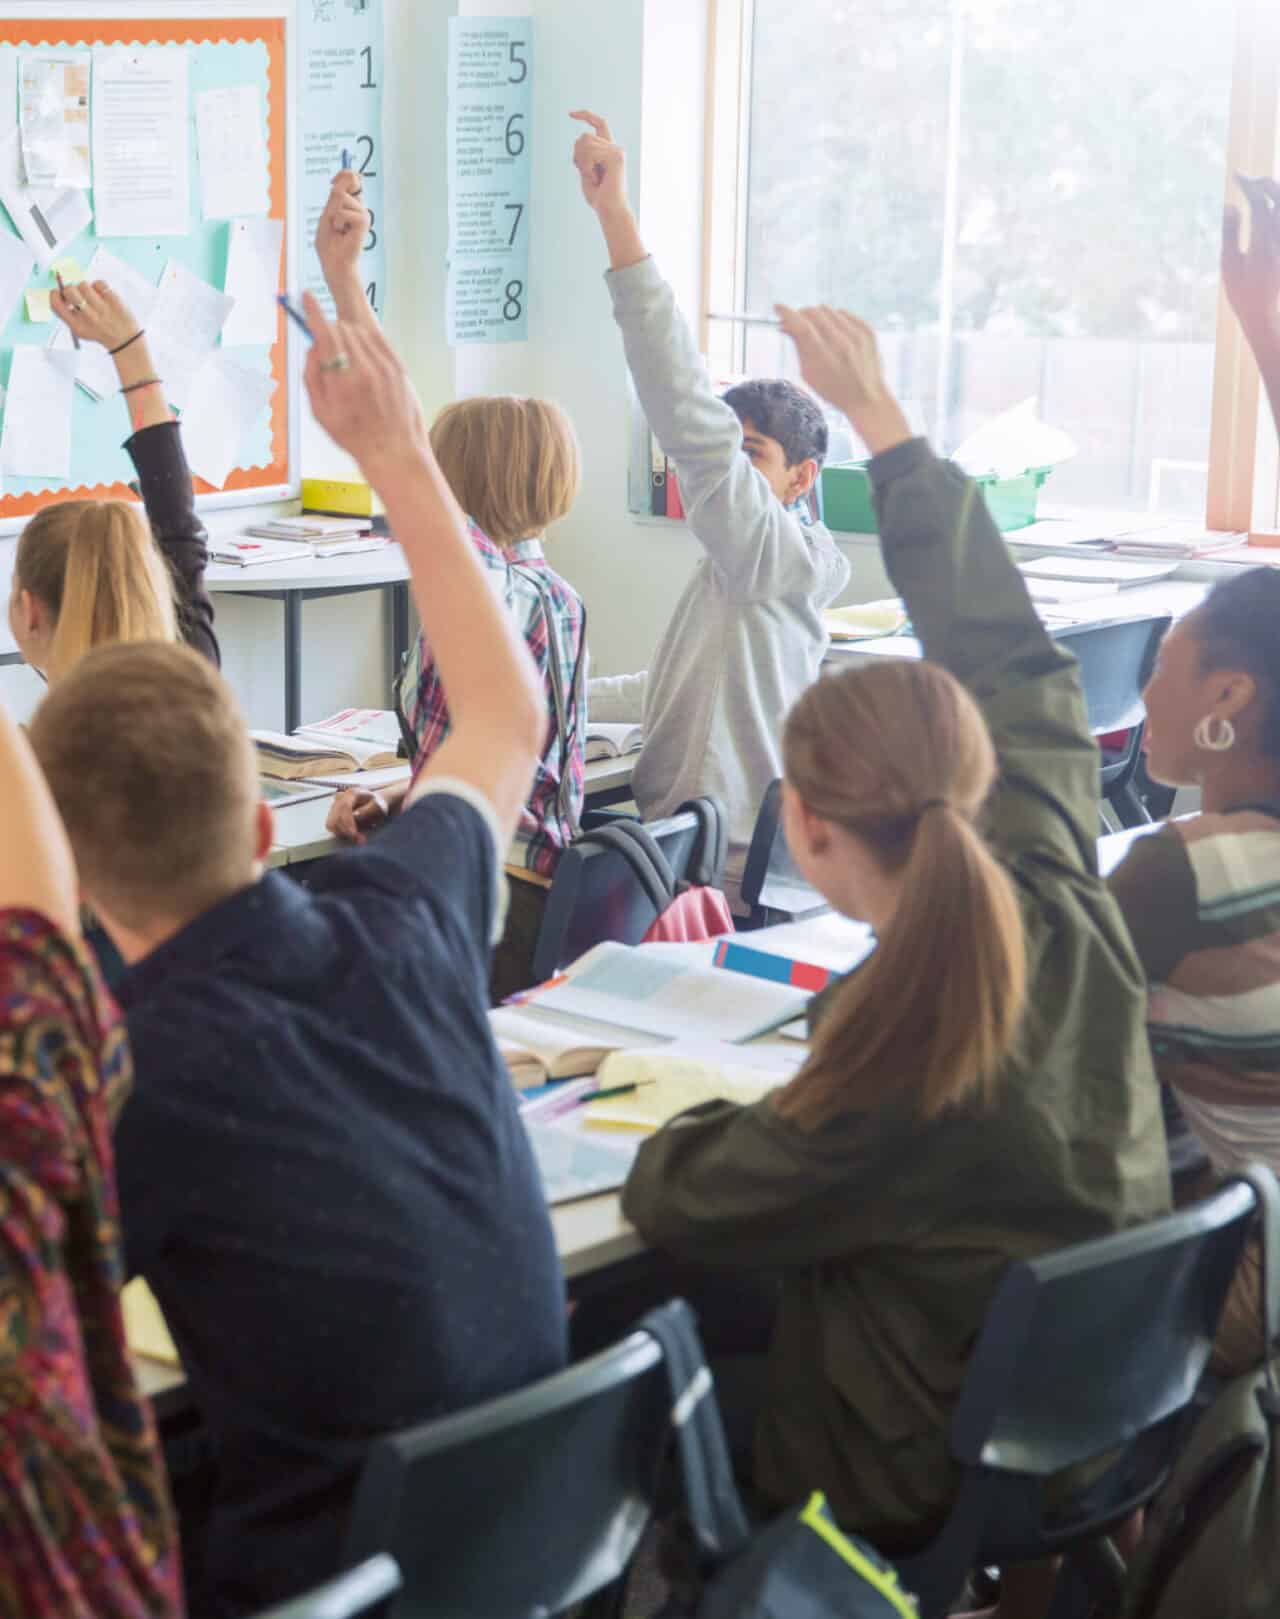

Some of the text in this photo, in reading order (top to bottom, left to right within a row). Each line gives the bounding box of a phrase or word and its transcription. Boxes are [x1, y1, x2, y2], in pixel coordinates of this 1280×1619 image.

[359, 45, 377, 88] 1
[507, 41, 527, 85] 5
[356, 135, 377, 177] 2
[505, 113, 525, 156] 6
[504, 203, 524, 246] 7
[503, 279, 522, 321] 8
